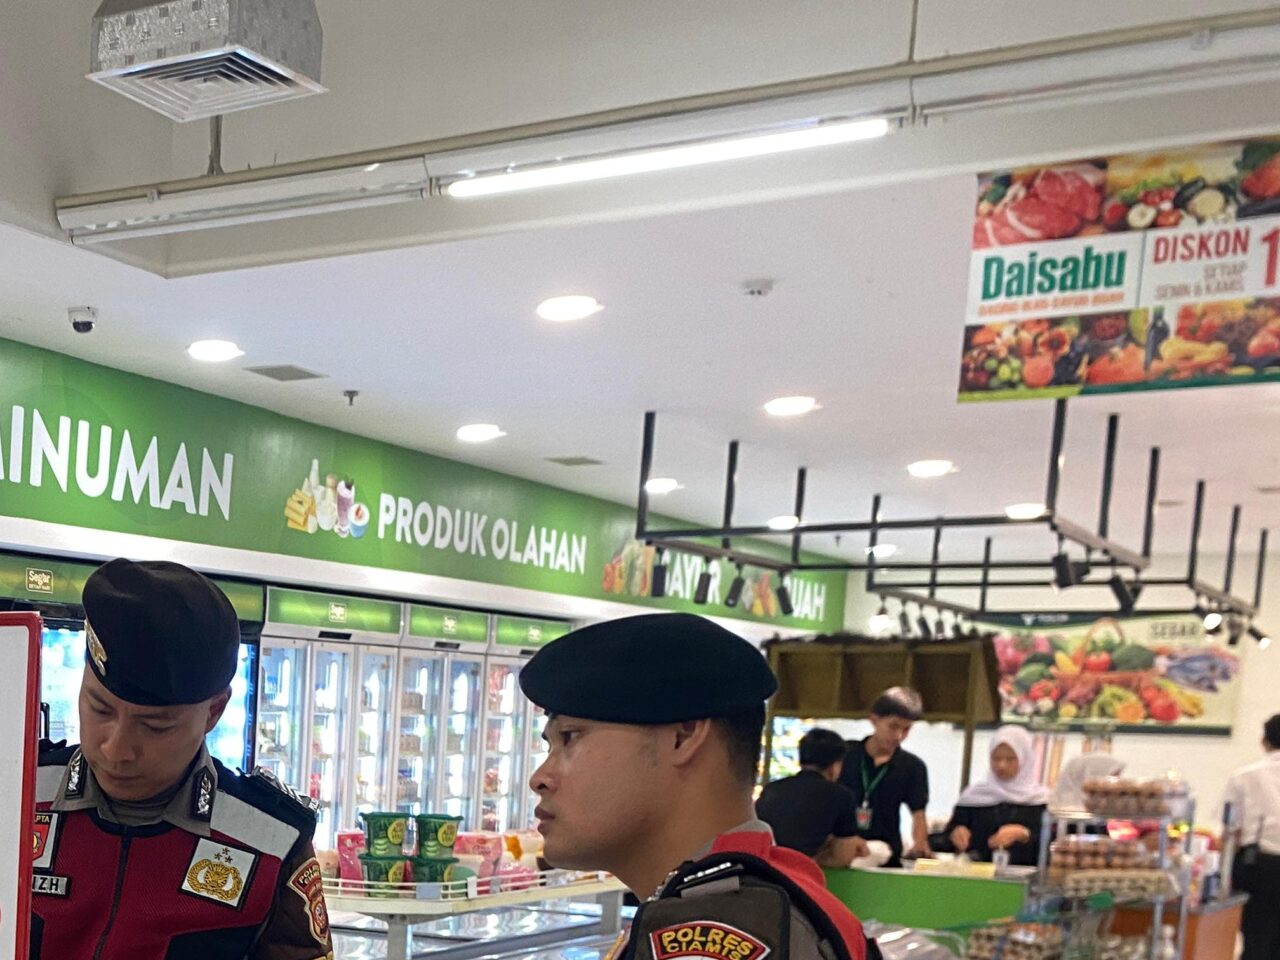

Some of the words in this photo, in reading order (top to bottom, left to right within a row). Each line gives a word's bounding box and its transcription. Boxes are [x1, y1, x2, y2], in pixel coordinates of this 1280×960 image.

[1154, 227, 1251, 265] DISKON
[981, 245, 1127, 300] Daisabu
[377, 492, 489, 557] PRODUK
[490, 517, 587, 575] OLAHAN
[28, 570, 52, 586] Segar
[661, 549, 721, 605] AYR
[782, 575, 827, 622] UAH
[661, 925, 754, 957] POLRES
